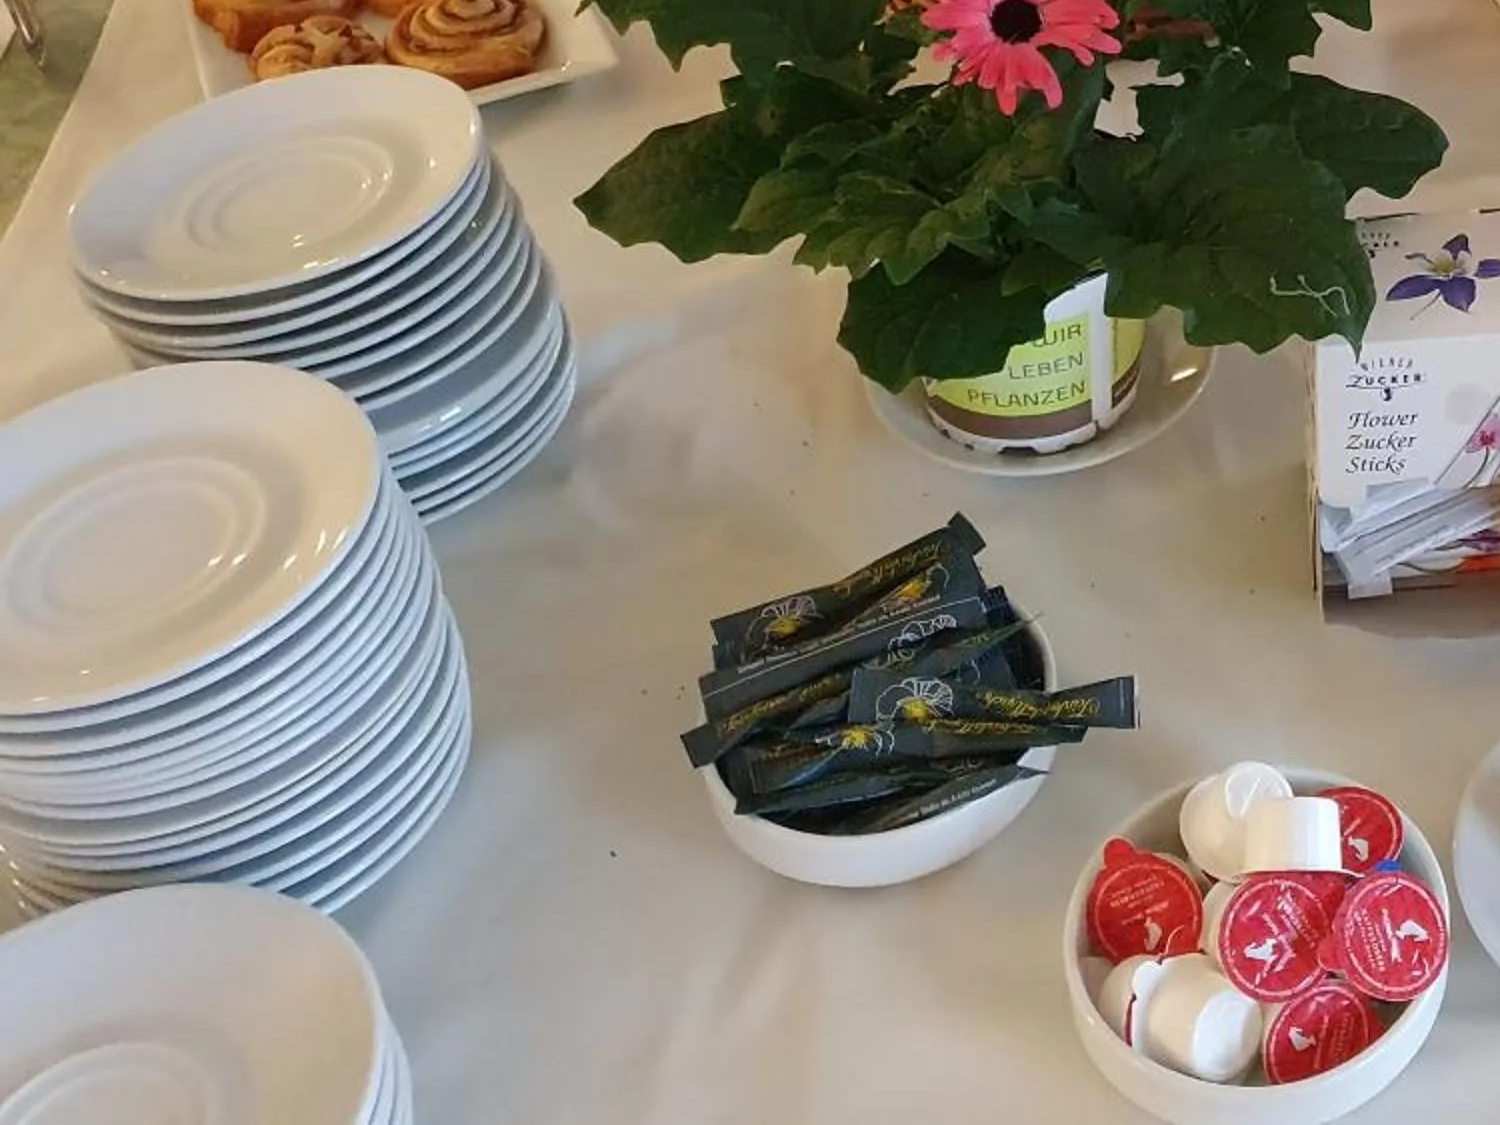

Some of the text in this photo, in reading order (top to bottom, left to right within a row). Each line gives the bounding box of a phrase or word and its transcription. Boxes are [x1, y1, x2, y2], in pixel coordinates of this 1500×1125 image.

[1008, 352, 1083, 380] LEBEN
[1345, 373, 1423, 389] ZUCKER
[967, 380, 1085, 408] PFLANZEN
[1347, 411, 1419, 430] Flower
[1344, 431, 1418, 453] Zucker
[1345, 454, 1407, 475] Sticks
